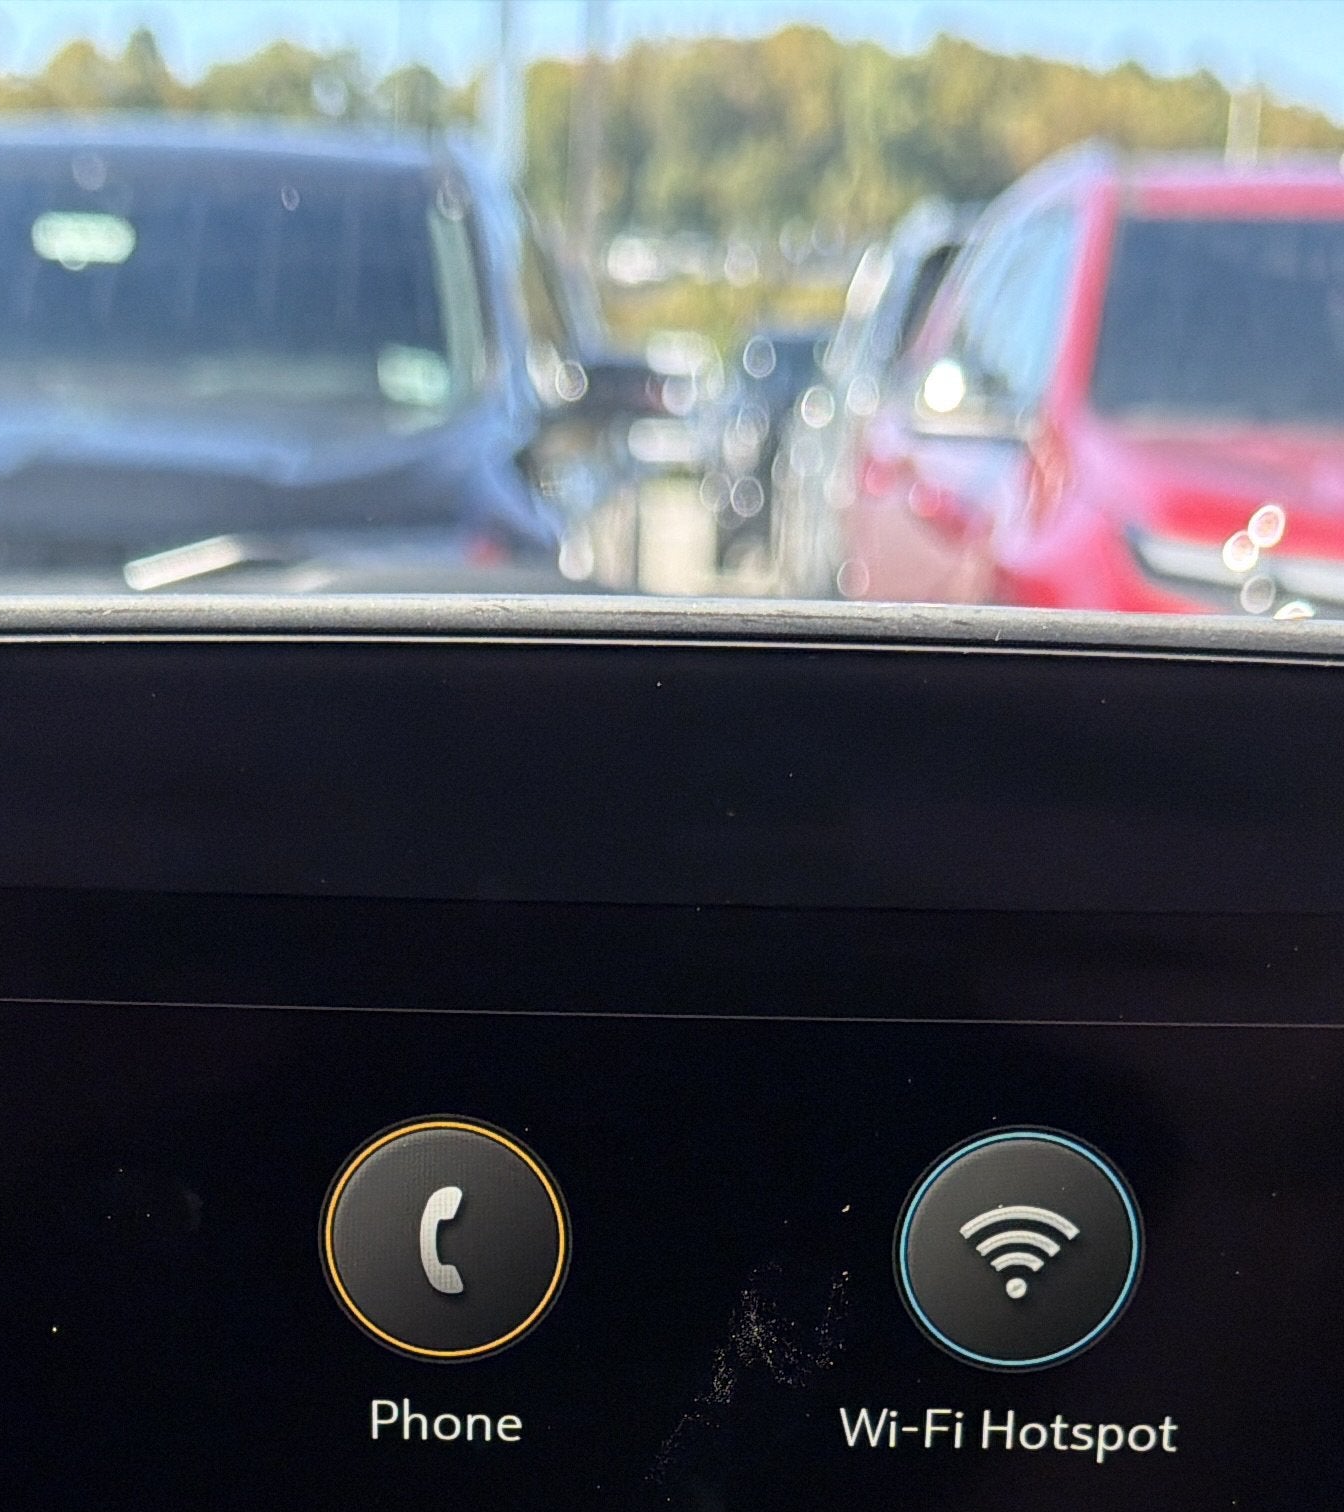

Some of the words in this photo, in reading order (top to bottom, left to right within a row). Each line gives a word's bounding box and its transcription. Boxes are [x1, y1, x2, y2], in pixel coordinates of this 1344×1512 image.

[371, 1397, 523, 1442] Phone
[839, 1407, 964, 1450] Wi-Fi
[981, 1409, 1179, 1465] Hotspot
